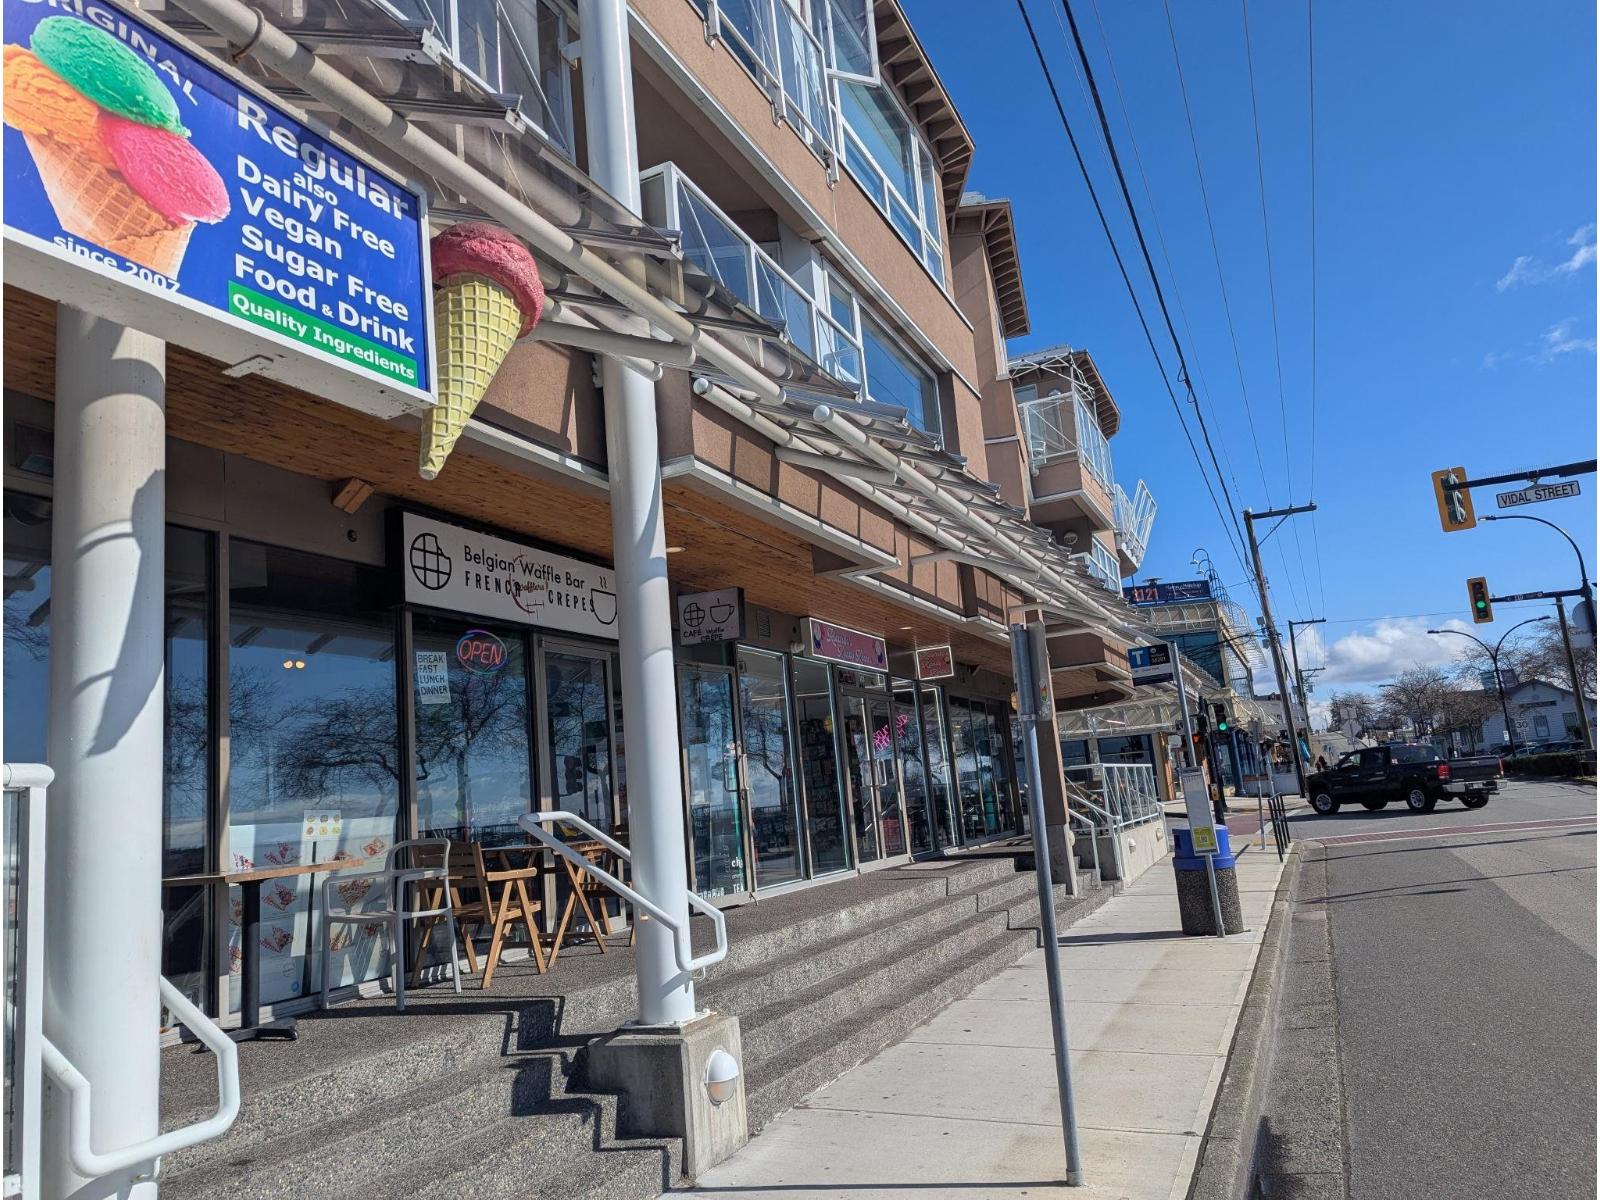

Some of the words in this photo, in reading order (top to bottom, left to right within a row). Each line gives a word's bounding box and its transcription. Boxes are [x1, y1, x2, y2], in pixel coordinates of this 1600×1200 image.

[20, 0, 197, 106] IGINAL
[238, 94, 408, 220] Regular
[237, 155, 324, 223] Dairy
[333, 208, 395, 259] Free
[293, 172, 338, 206] also
[240, 187, 342, 259] Vegan
[53, 235, 118, 267] since
[125, 262, 181, 293] 2007
[241, 224, 339, 286] Sugar
[348, 274, 408, 321] Free
[235, 253, 316, 310] Food
[321, 303, 335, 319] &
[338, 300, 415, 354] Drink
[232, 293, 308, 337] Quality
[313, 326, 415, 380] Ingredients
[1500, 491, 1531, 506] VIDAL
[1534, 483, 1575, 500] STREET
[464, 544, 515, 573] Belgian
[519, 559, 562, 584] Waffle
[565, 572, 585, 590] Bar
[418, 664, 438, 674] FAST
[459, 639, 502, 665] OPEN
[1132, 650, 1144, 665] T
[419, 674, 446, 684] LUNCH
[420, 685, 449, 696] DINNER
[1516, 721, 1528, 729] 30
